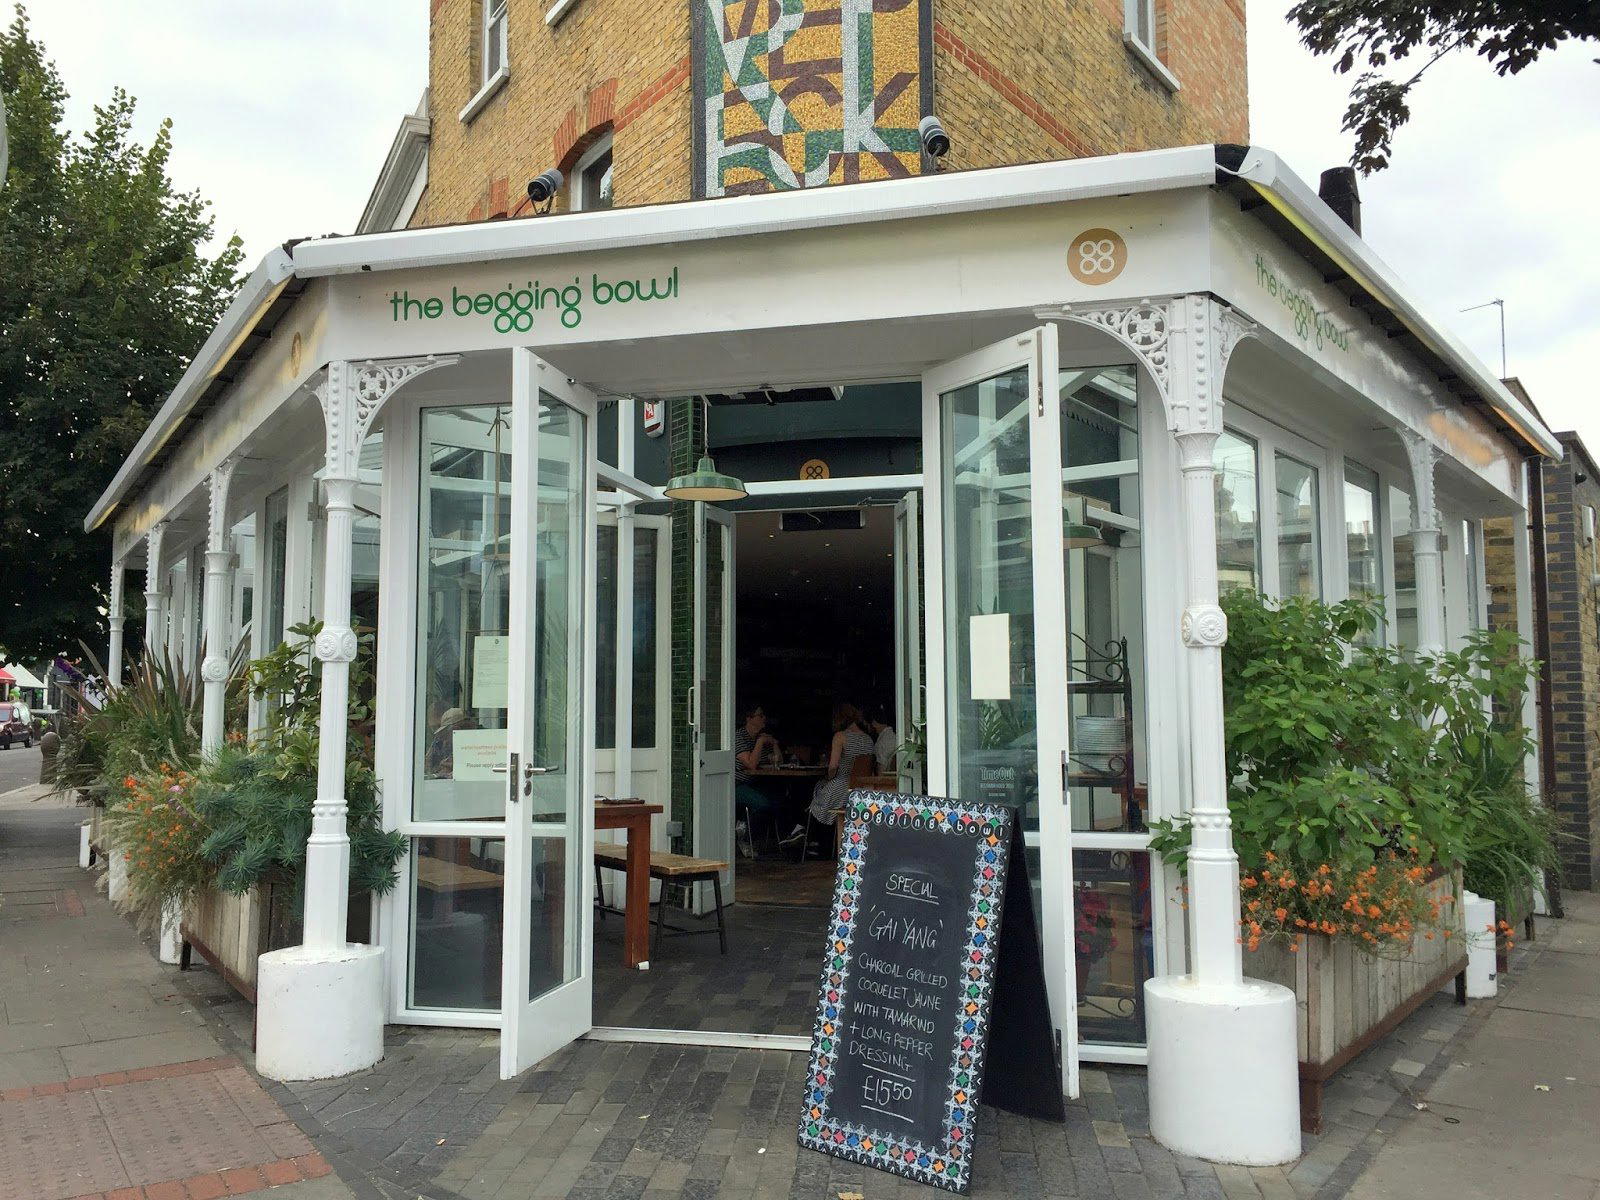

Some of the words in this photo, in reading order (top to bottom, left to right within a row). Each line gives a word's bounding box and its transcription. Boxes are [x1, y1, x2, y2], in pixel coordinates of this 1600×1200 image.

[1255, 253, 1277, 297] the
[390, 290, 444, 322] the
[452, 276, 582, 333] begging
[592, 266, 679, 305] bowl
[850, 807, 936, 831] begging
[955, 819, 1004, 837] bowl
[886, 874, 938, 898] SPECIAL
[858, 952, 904, 978] CHARCOAL
[906, 967, 948, 989] GRILLED
[858, 976, 909, 1000] COQUELET
[853, 1001, 879, 1018] WITH
[881, 1006, 935, 1034] TAMARIND
[849, 1021, 860, 1035] +
[861, 1024, 891, 1047] LONG
[893, 1032, 934, 1061] PEPPER
[849, 1040, 912, 1072] DRESSING
